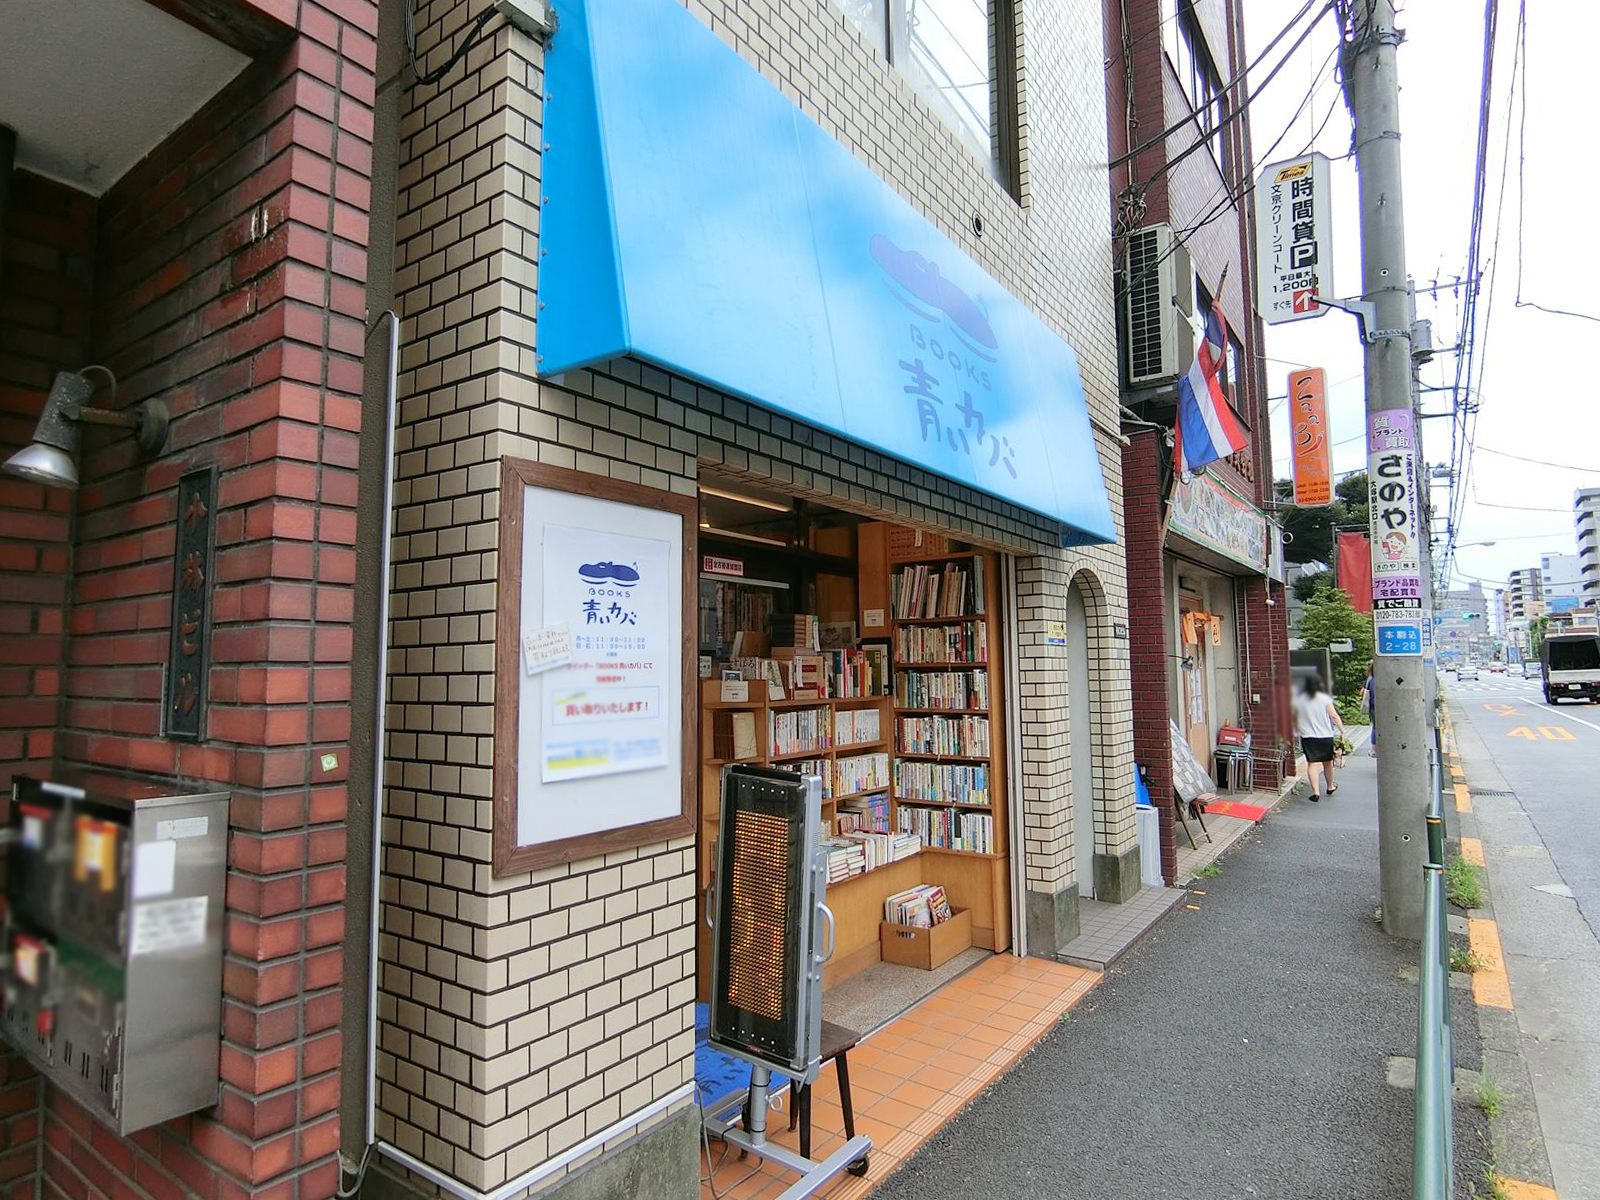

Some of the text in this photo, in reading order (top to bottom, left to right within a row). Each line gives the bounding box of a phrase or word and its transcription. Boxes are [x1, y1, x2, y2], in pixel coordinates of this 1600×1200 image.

[1279, 165, 1308, 181] Times
[1271, 184, 1283, 274] 文京グリーンコート
[910, 323, 992, 391] BOOKS
[898, 357, 1018, 480] 青いカバ
[1384, 436, 1410, 449] 買取
[1377, 454, 1407, 530] さのや
[1376, 563, 1396, 571] さのや
[588, 587, 631, 598] BOOKS
[1380, 588, 1417, 597] 宅配買取
[583, 599, 637, 625] 青いカバ
[1384, 630, 1417, 640] 本駒込
[1385, 641, 1417, 651] 2-28
[1506, 726, 1577, 741] 40
